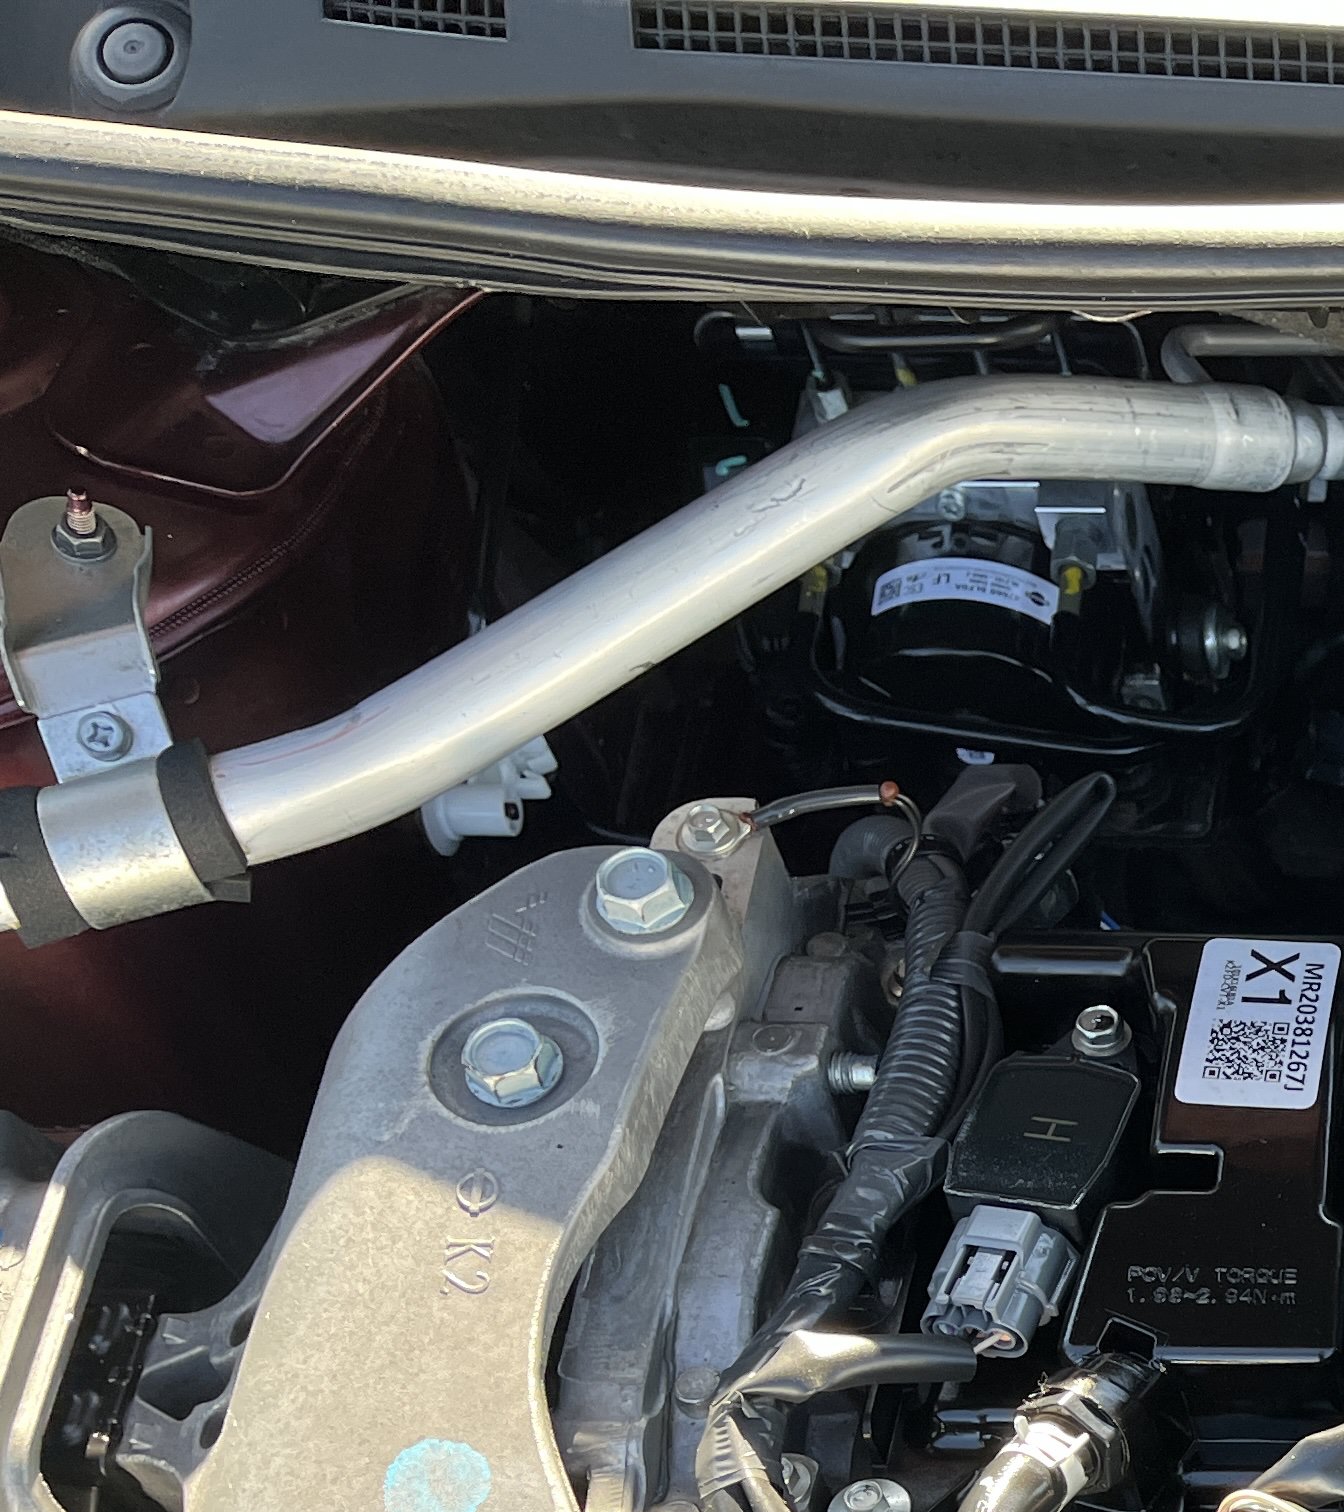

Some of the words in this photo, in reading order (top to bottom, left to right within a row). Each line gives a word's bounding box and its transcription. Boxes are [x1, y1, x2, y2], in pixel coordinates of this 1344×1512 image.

[1284, 963, 1325, 1091] MR20381267J
[440, 1236, 497, 1297] K2
[1127, 1264, 1200, 1283] PCV/V
[1214, 1267, 1298, 1284] TORQUE
